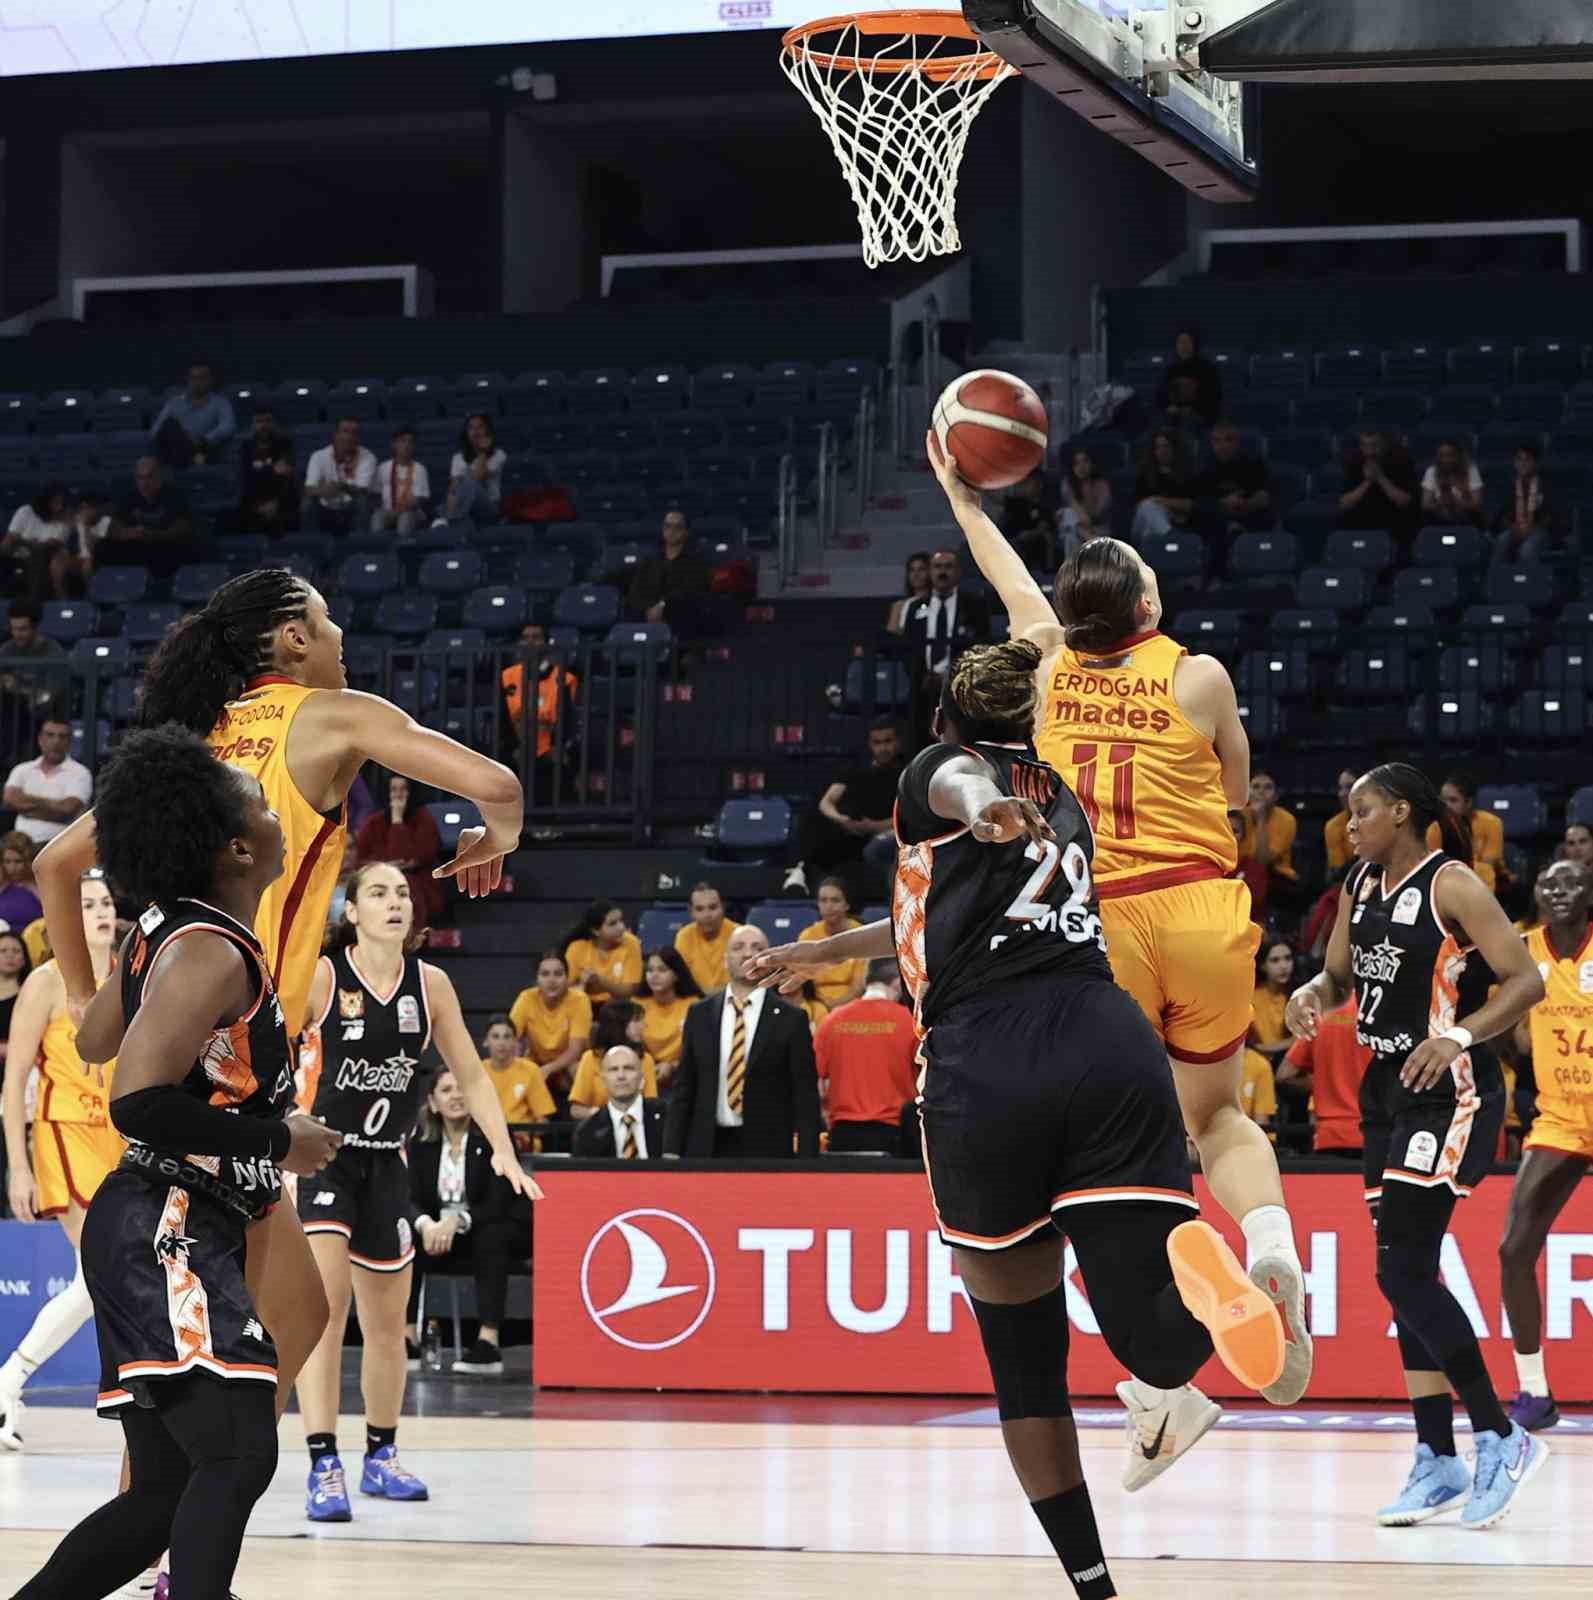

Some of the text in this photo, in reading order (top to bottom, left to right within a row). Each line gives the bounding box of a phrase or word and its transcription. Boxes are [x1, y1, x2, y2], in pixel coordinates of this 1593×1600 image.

[1071, 743, 1136, 840] 11
[1358, 981, 1384, 1025] 12
[335, 1054, 416, 1093] Mersin
[364, 1097, 390, 1137] 0
[738, 1228, 1339, 1337] TURH
